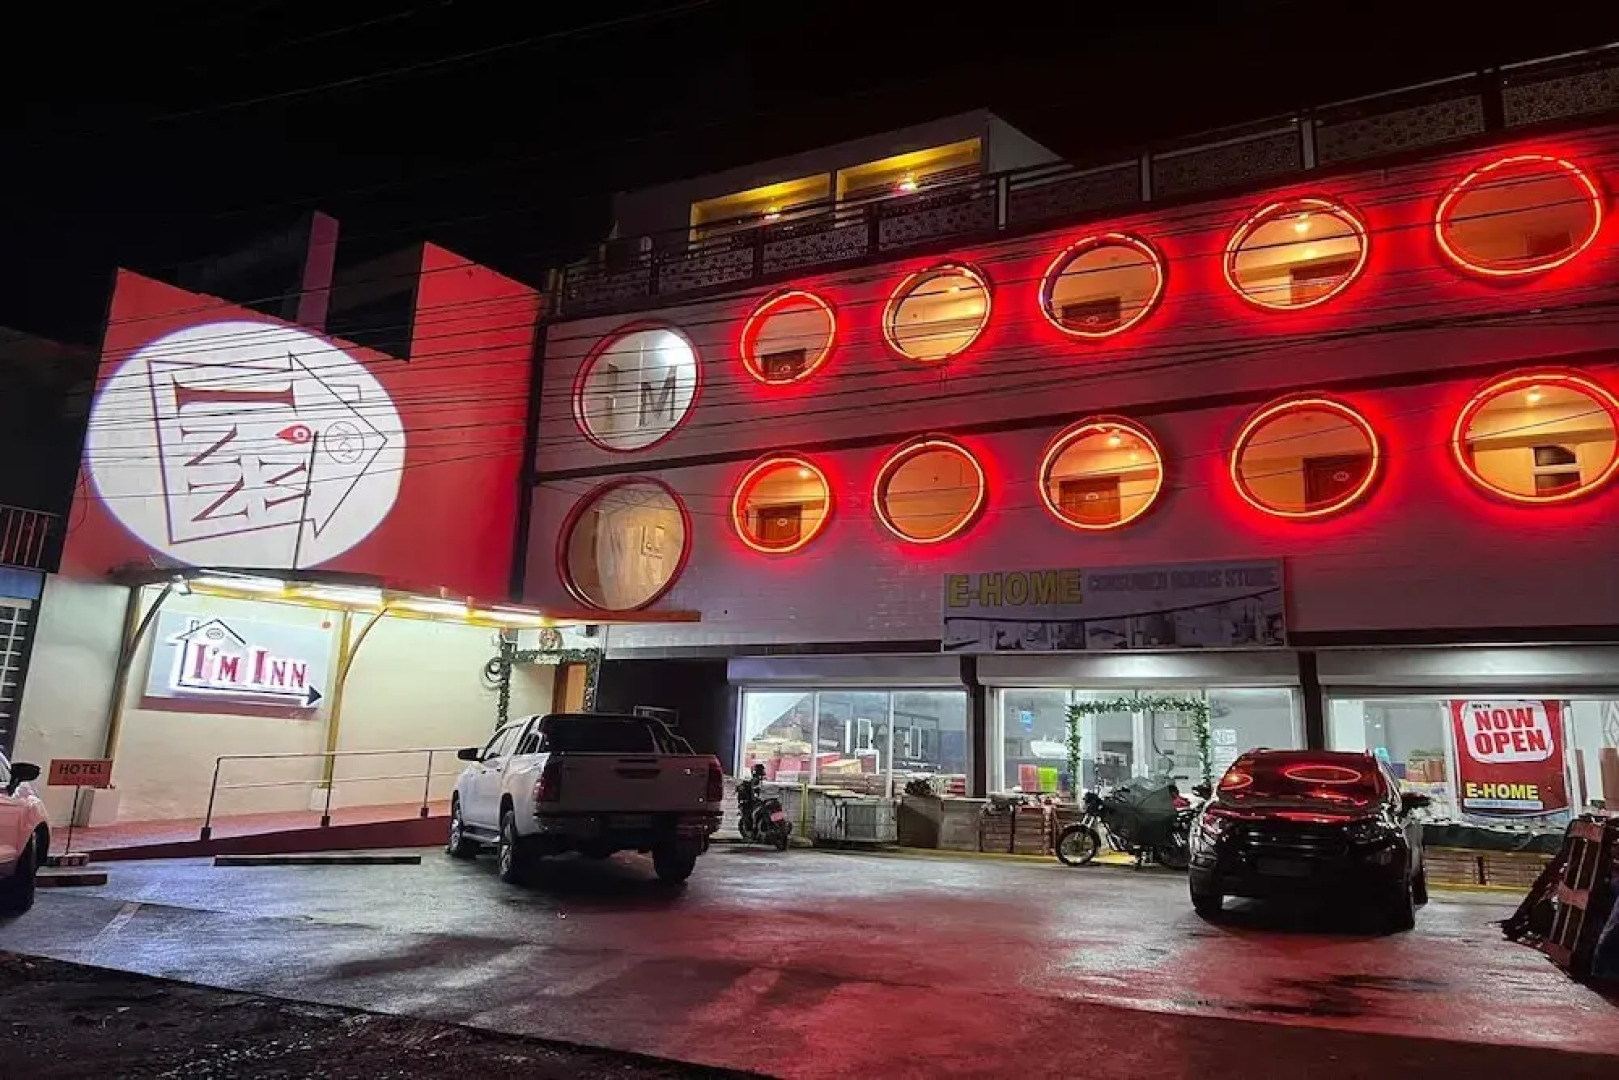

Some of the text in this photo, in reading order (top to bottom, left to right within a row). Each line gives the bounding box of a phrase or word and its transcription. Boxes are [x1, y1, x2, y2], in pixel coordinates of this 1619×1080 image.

[948, 567, 1083, 608] E-HOME
[253, 650, 307, 689] INN
[1474, 707, 1534, 731] NOW
[1474, 730, 1547, 754] OPEN
[59, 763, 102, 775] HOTEL
[1466, 782, 1539, 799] E-HOME
